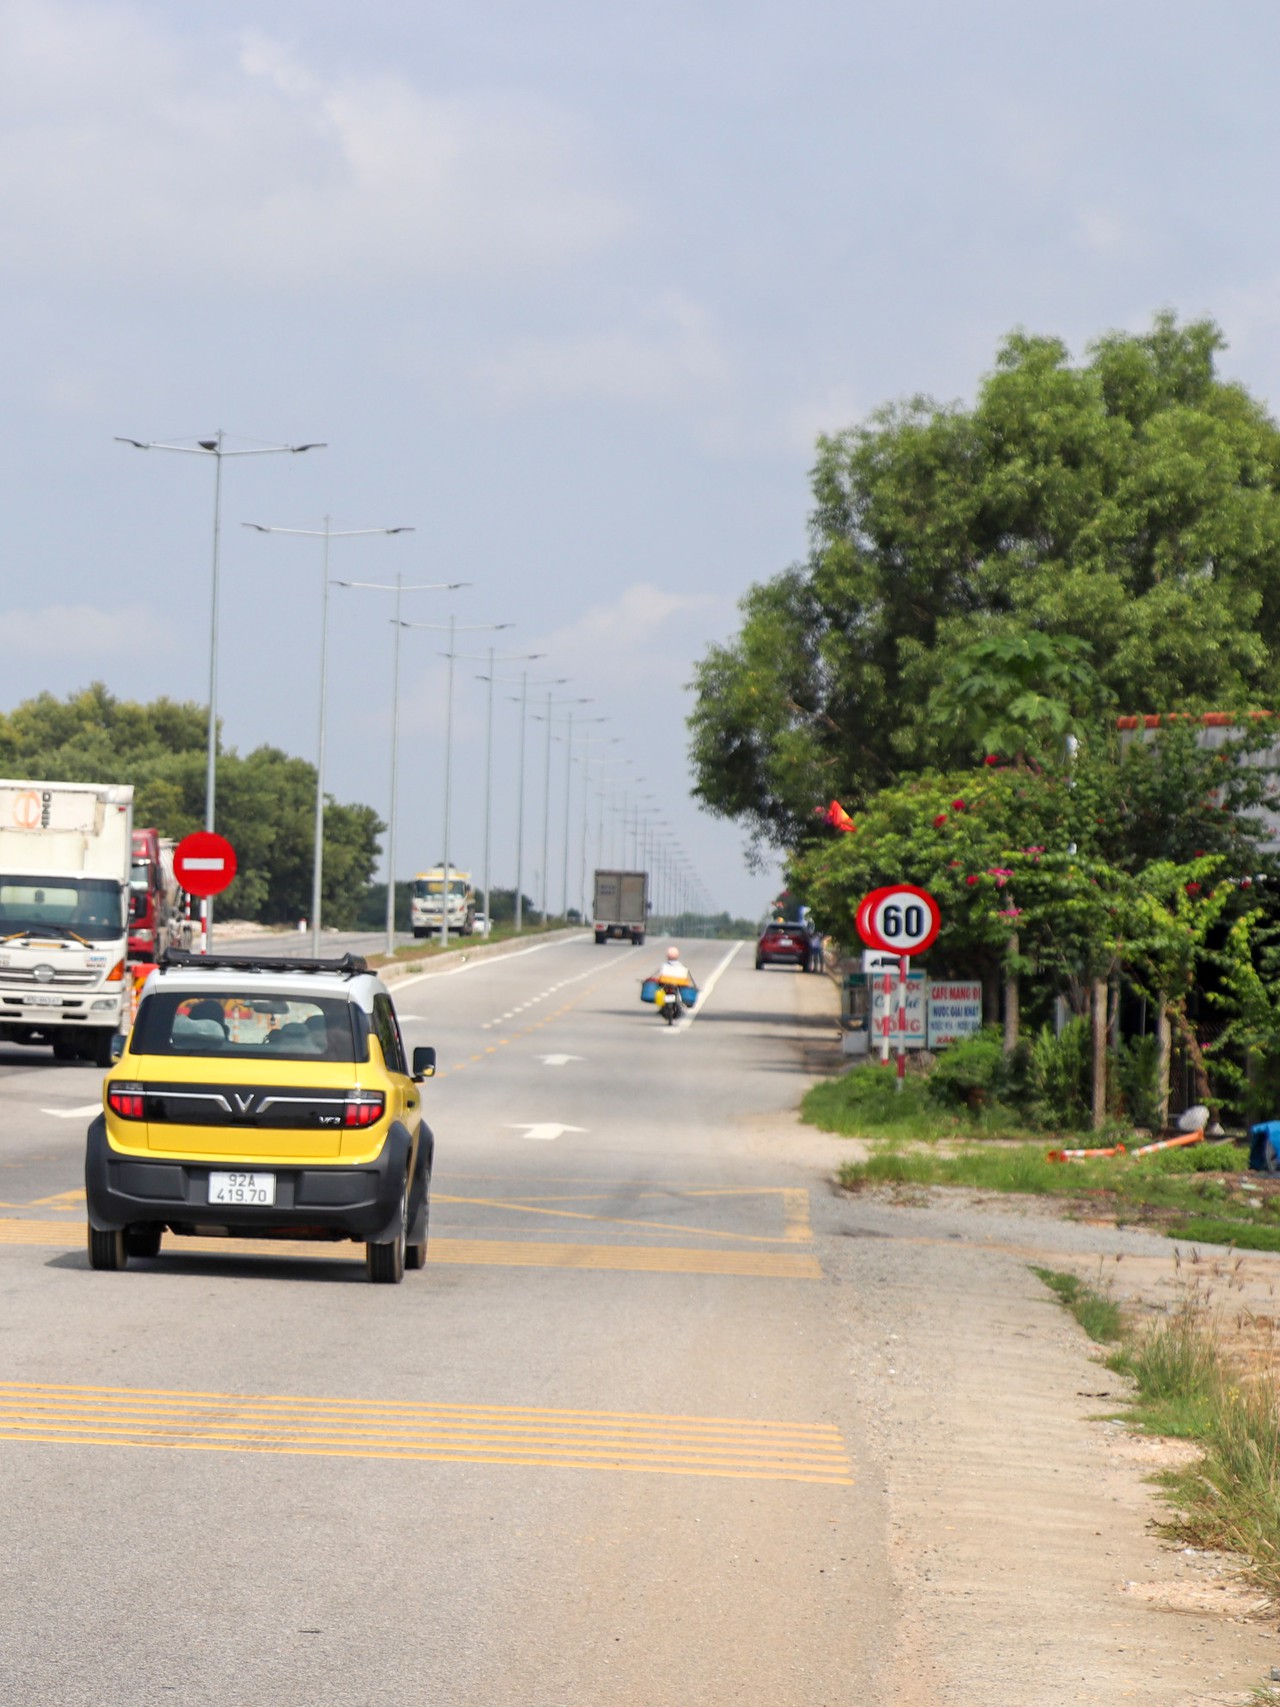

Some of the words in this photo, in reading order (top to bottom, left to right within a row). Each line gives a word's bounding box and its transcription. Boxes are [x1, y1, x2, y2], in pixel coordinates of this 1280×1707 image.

[884, 905, 924, 937] 60
[229, 1174, 255, 1188] 92A
[217, 1189, 267, 1202] 419.70
